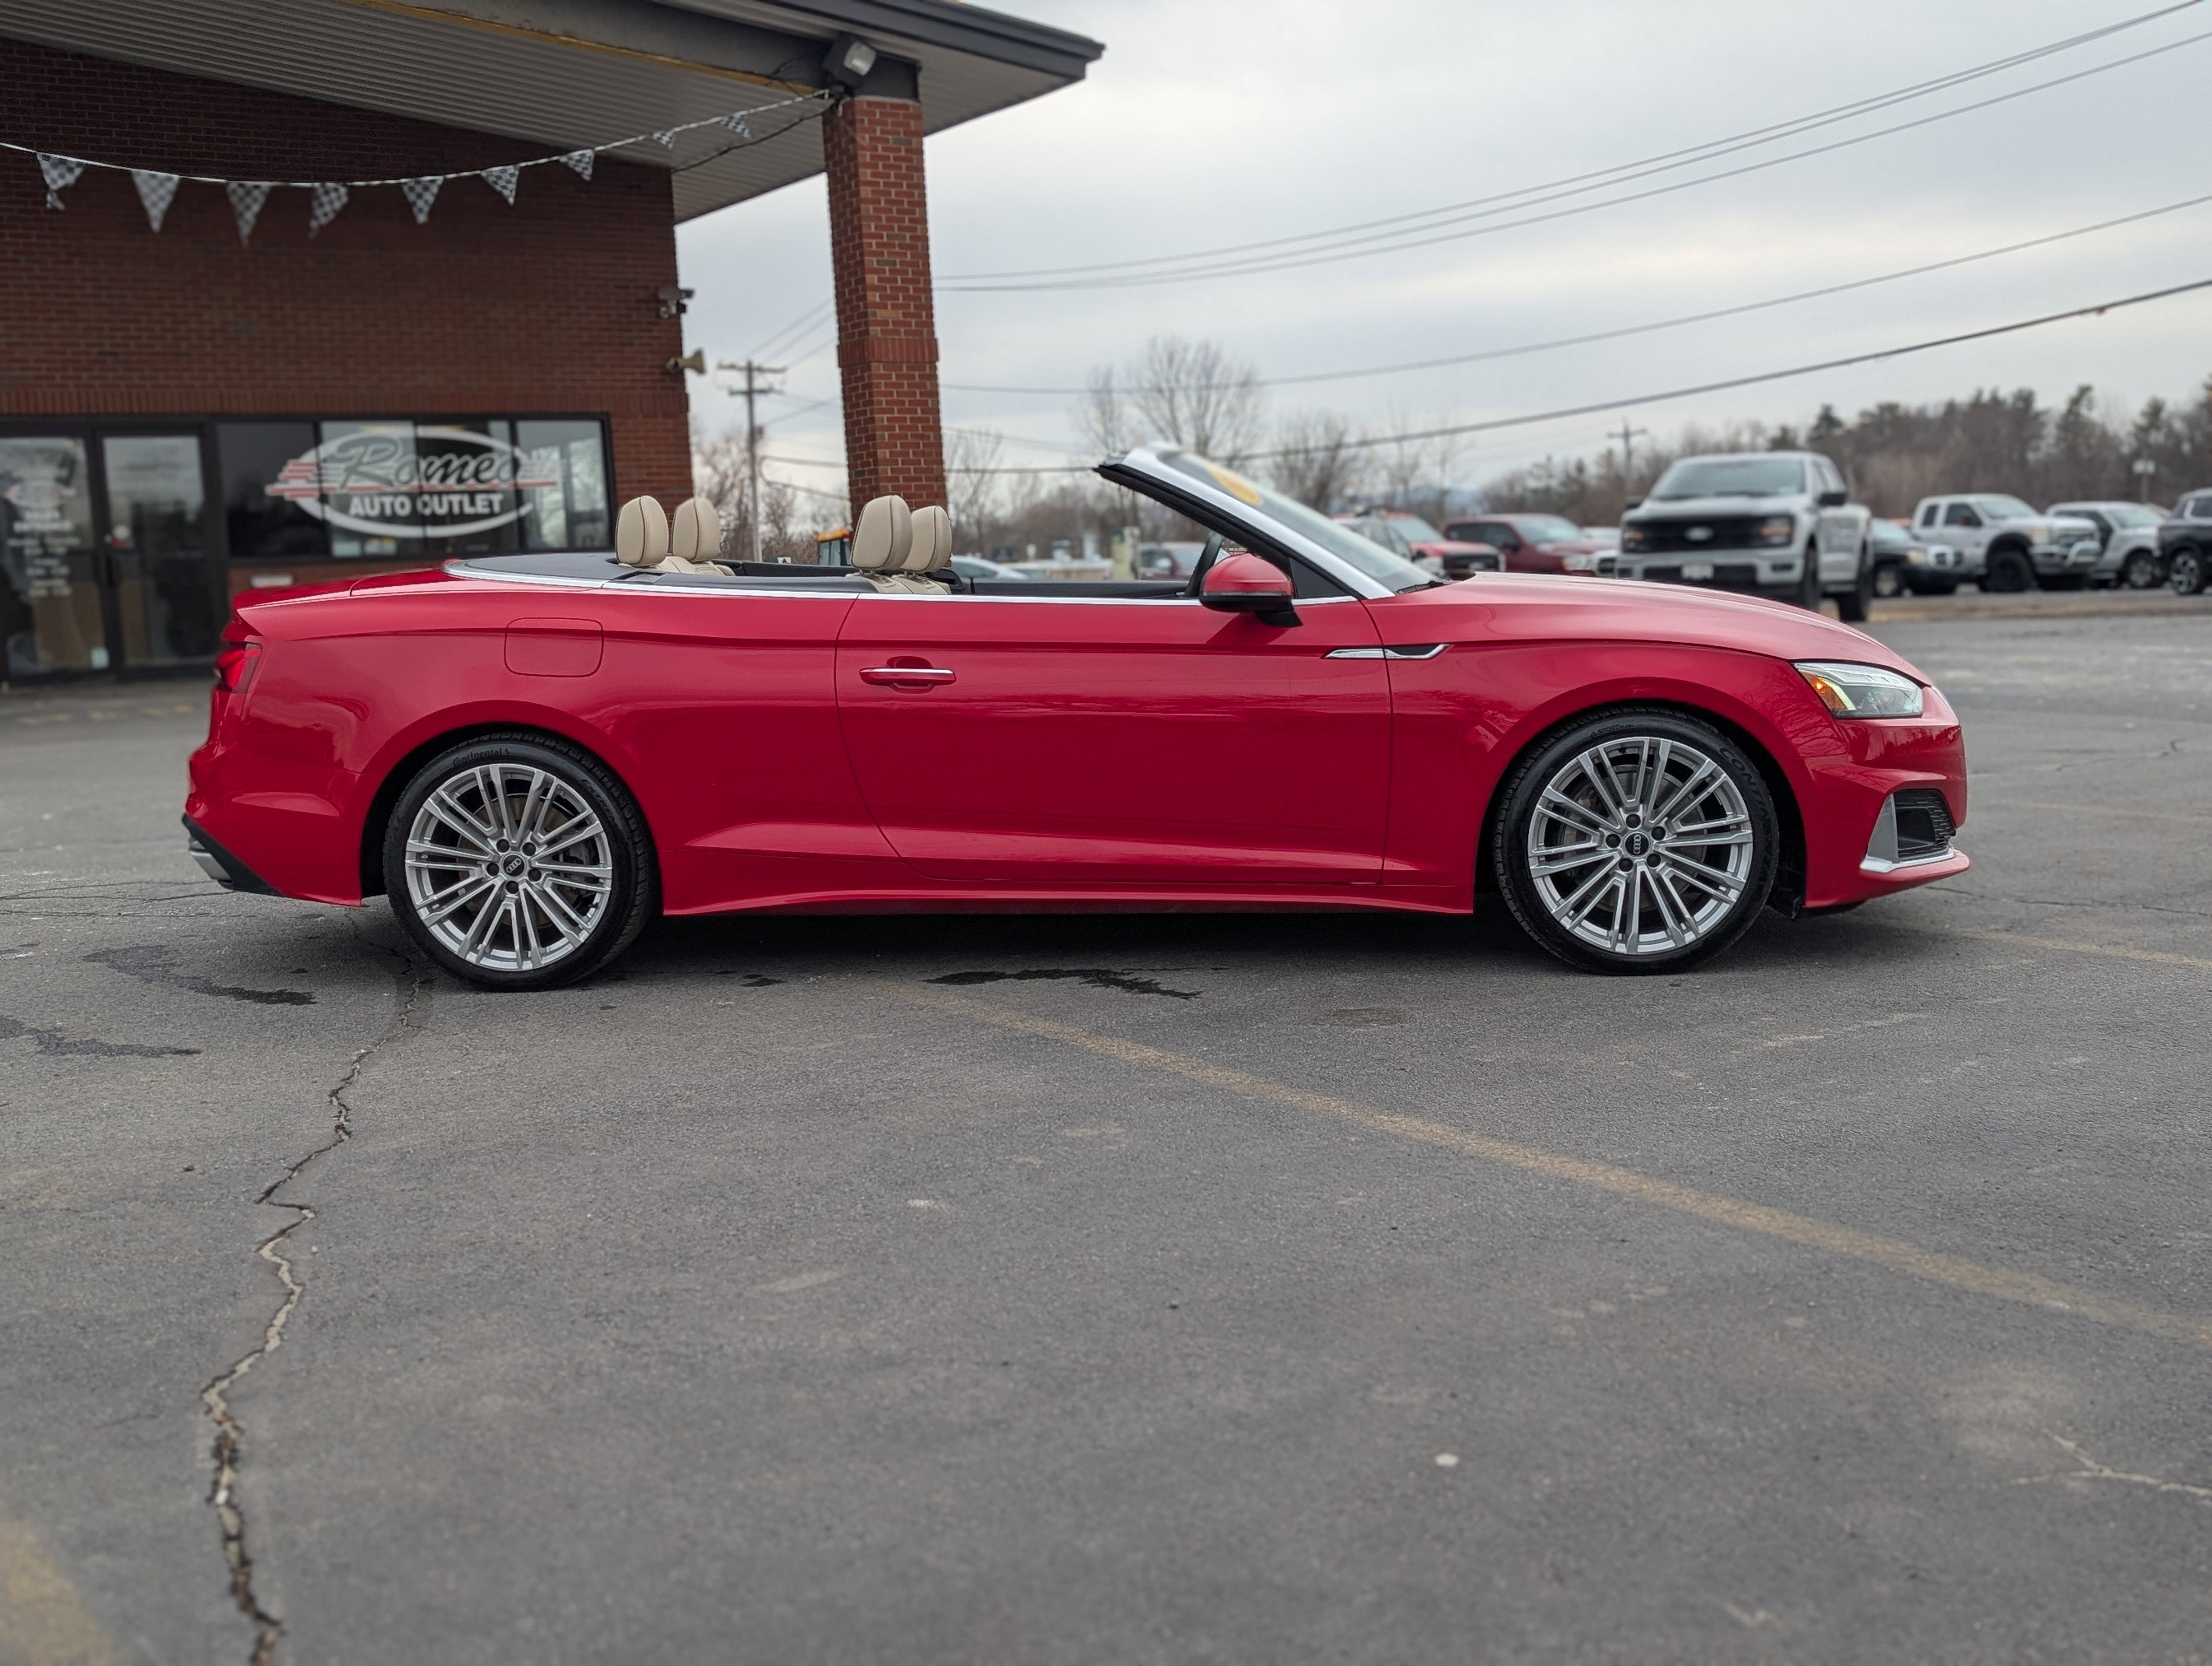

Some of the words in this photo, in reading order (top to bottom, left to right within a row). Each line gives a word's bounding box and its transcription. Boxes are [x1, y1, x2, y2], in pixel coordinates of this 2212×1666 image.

[326, 435, 519, 489] Romeo
[348, 493, 412, 517] AUTO
[416, 492, 504, 515] OUTLET
[453, 748, 501, 766] Continental
